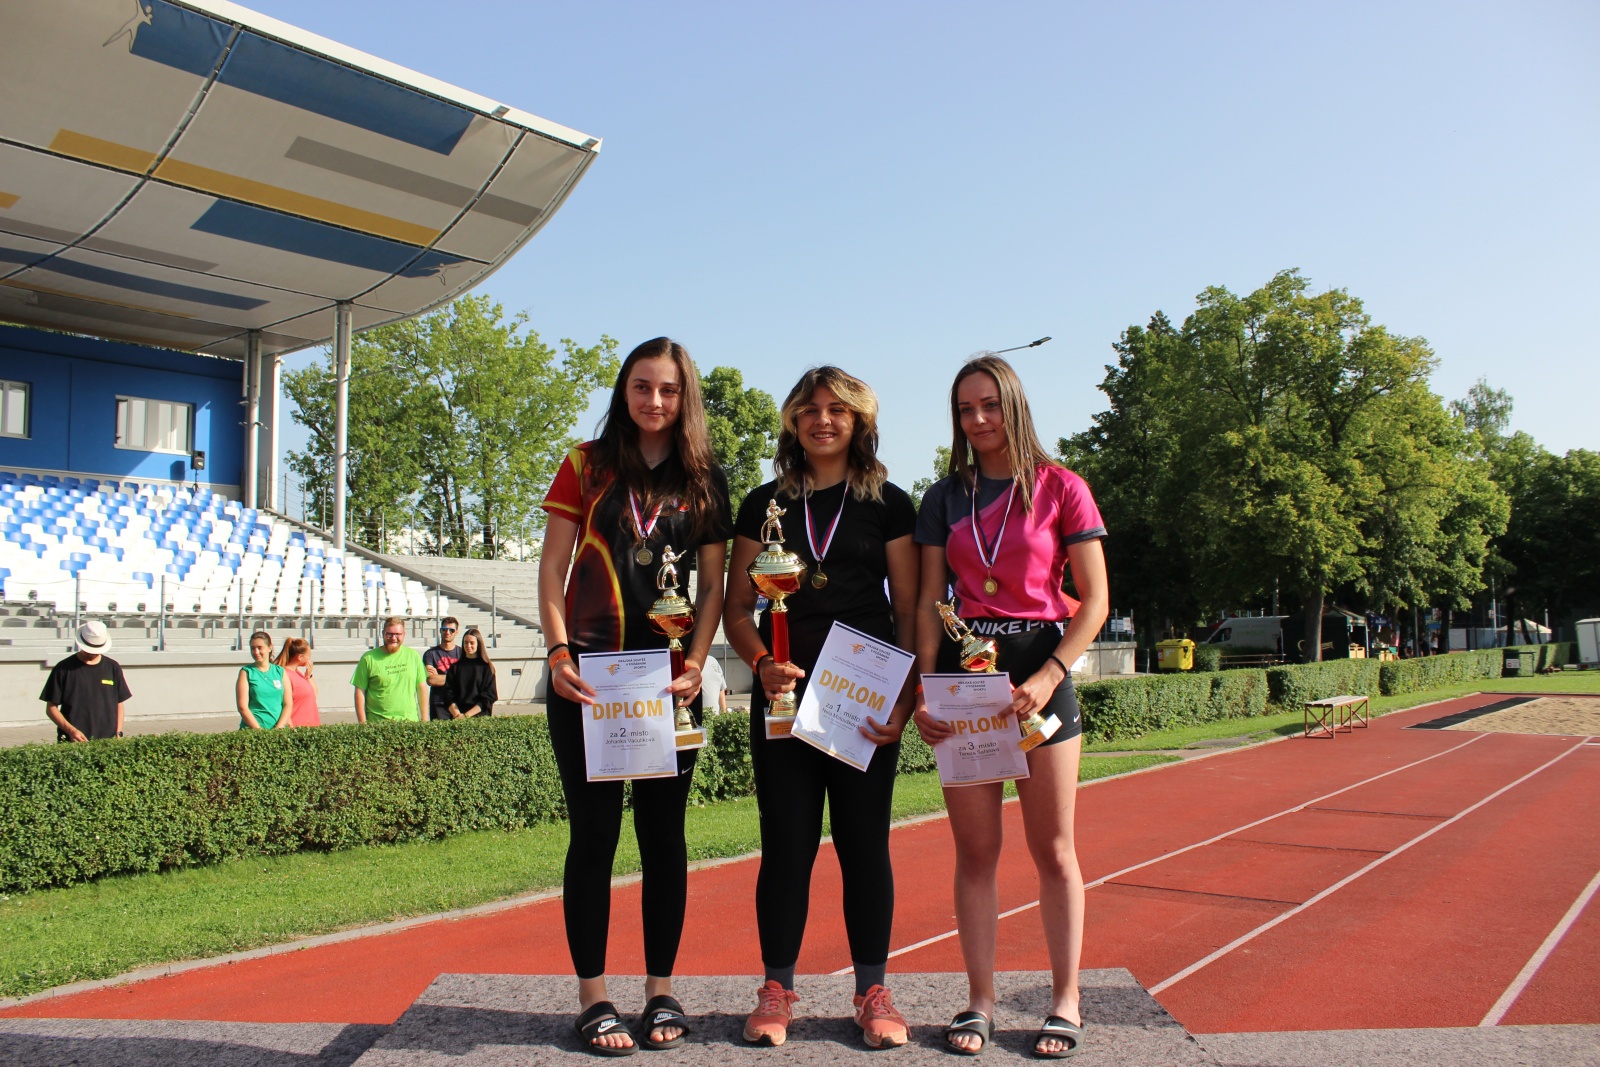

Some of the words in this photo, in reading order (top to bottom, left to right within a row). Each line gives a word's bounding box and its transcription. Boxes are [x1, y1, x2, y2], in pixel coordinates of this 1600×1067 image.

[971, 620, 1022, 635] NIKE
[819, 669, 886, 712] DIPLOM
[592, 699, 663, 720] DIPLOM
[825, 702, 834, 710] za
[600, 1018, 617, 1028] NIKE
